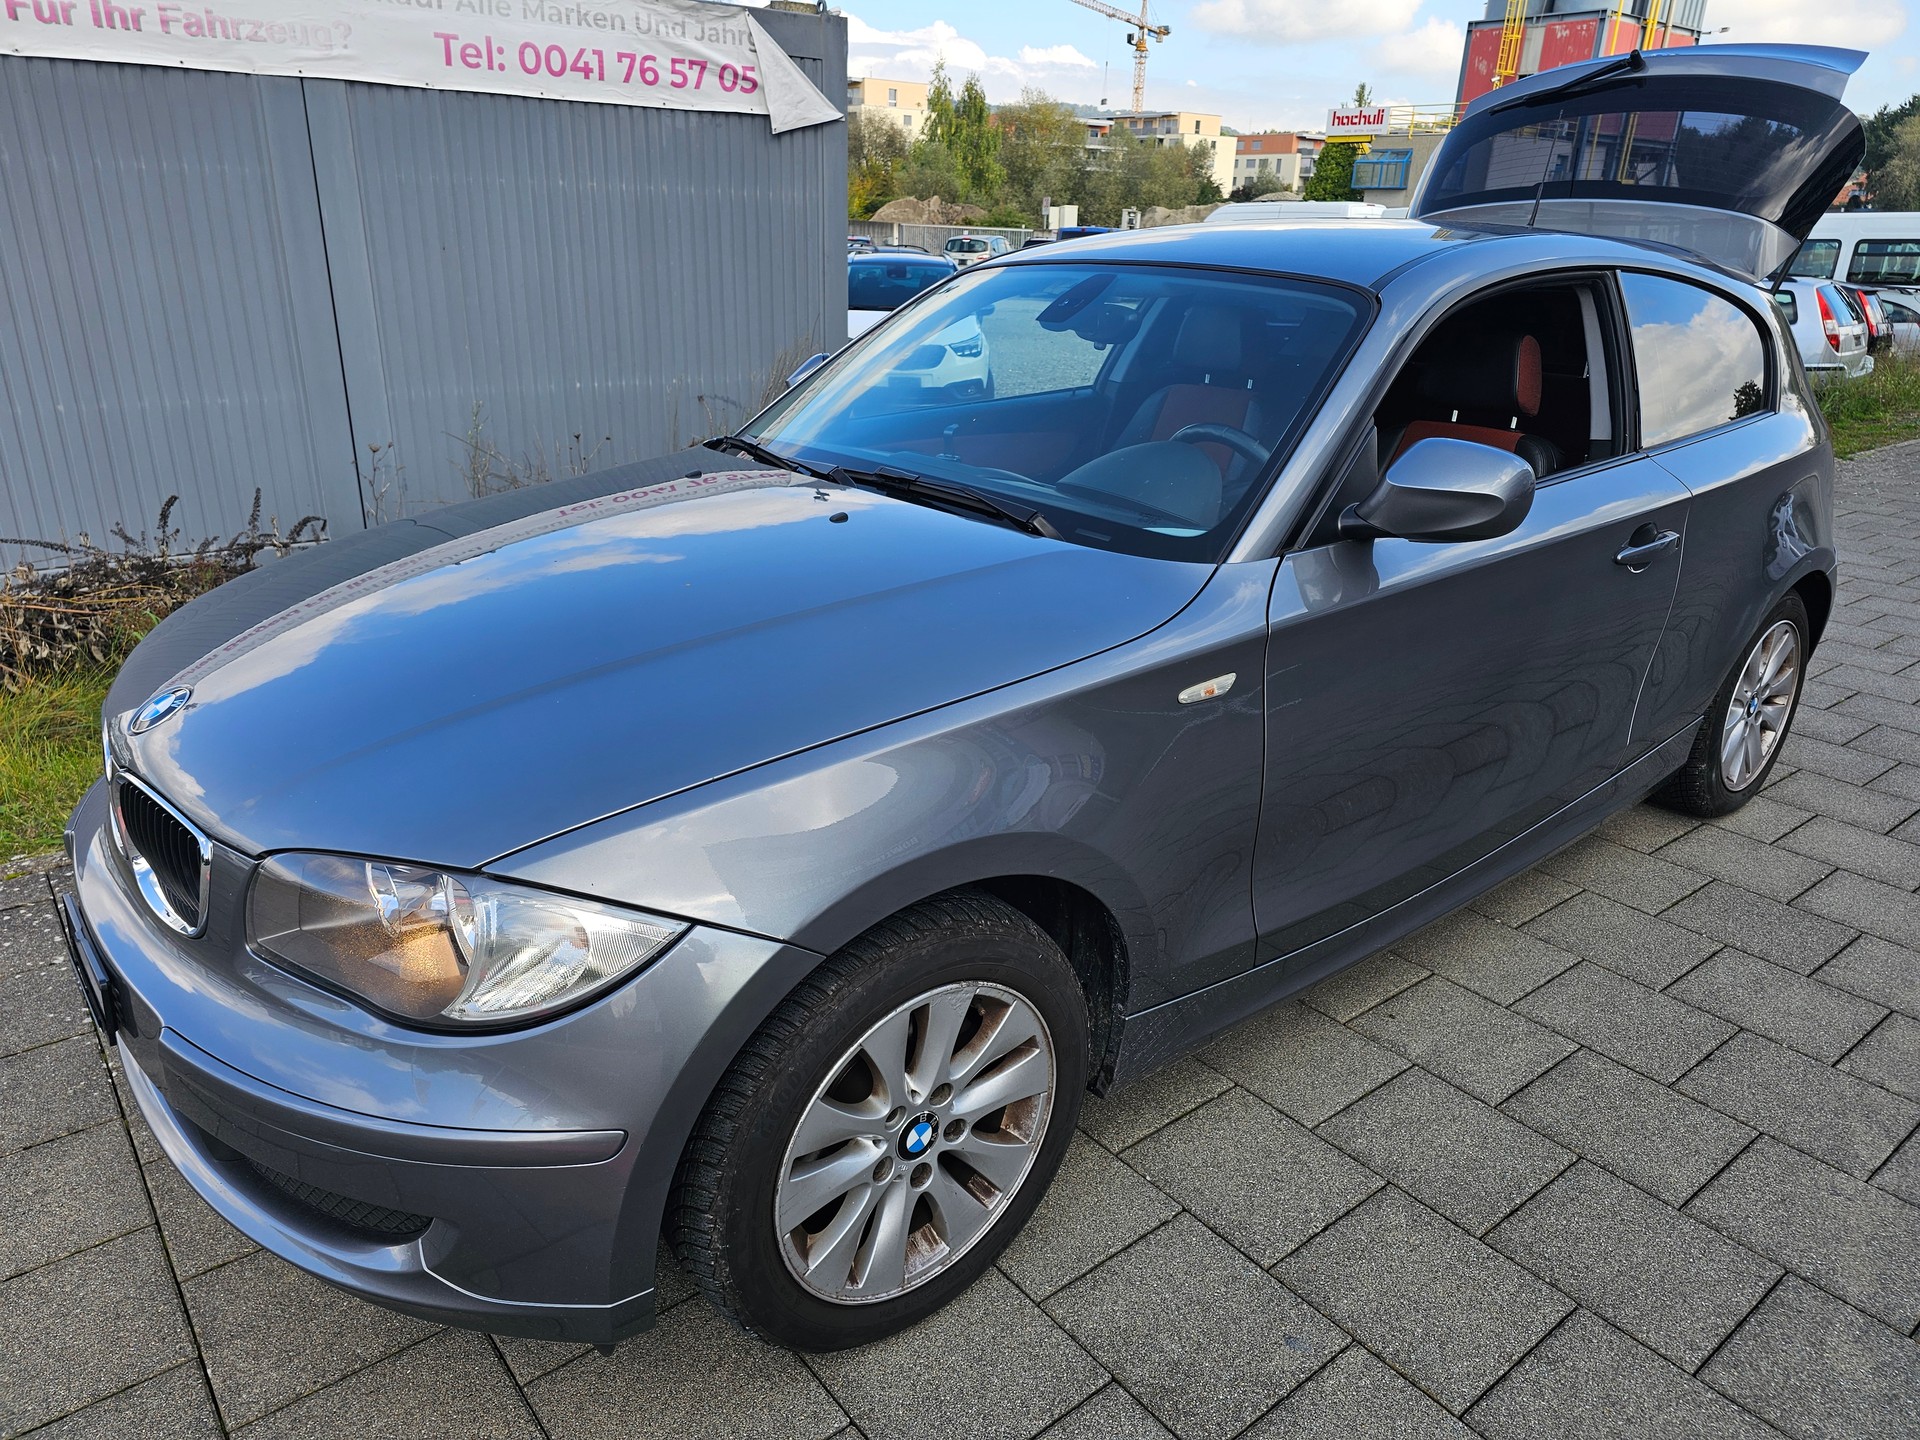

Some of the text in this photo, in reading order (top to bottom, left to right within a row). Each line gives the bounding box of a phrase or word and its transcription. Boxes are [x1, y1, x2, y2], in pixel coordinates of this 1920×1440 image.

[89, 0, 147, 32] Ihr
[156, 2, 353, 51] Fahrzeug?
[455, 0, 512, 17] Alle
[522, 0, 626, 32] Marken
[635, 11, 687, 39] Und
[433, 31, 759, 95] Tel: 0041 76 57 05
